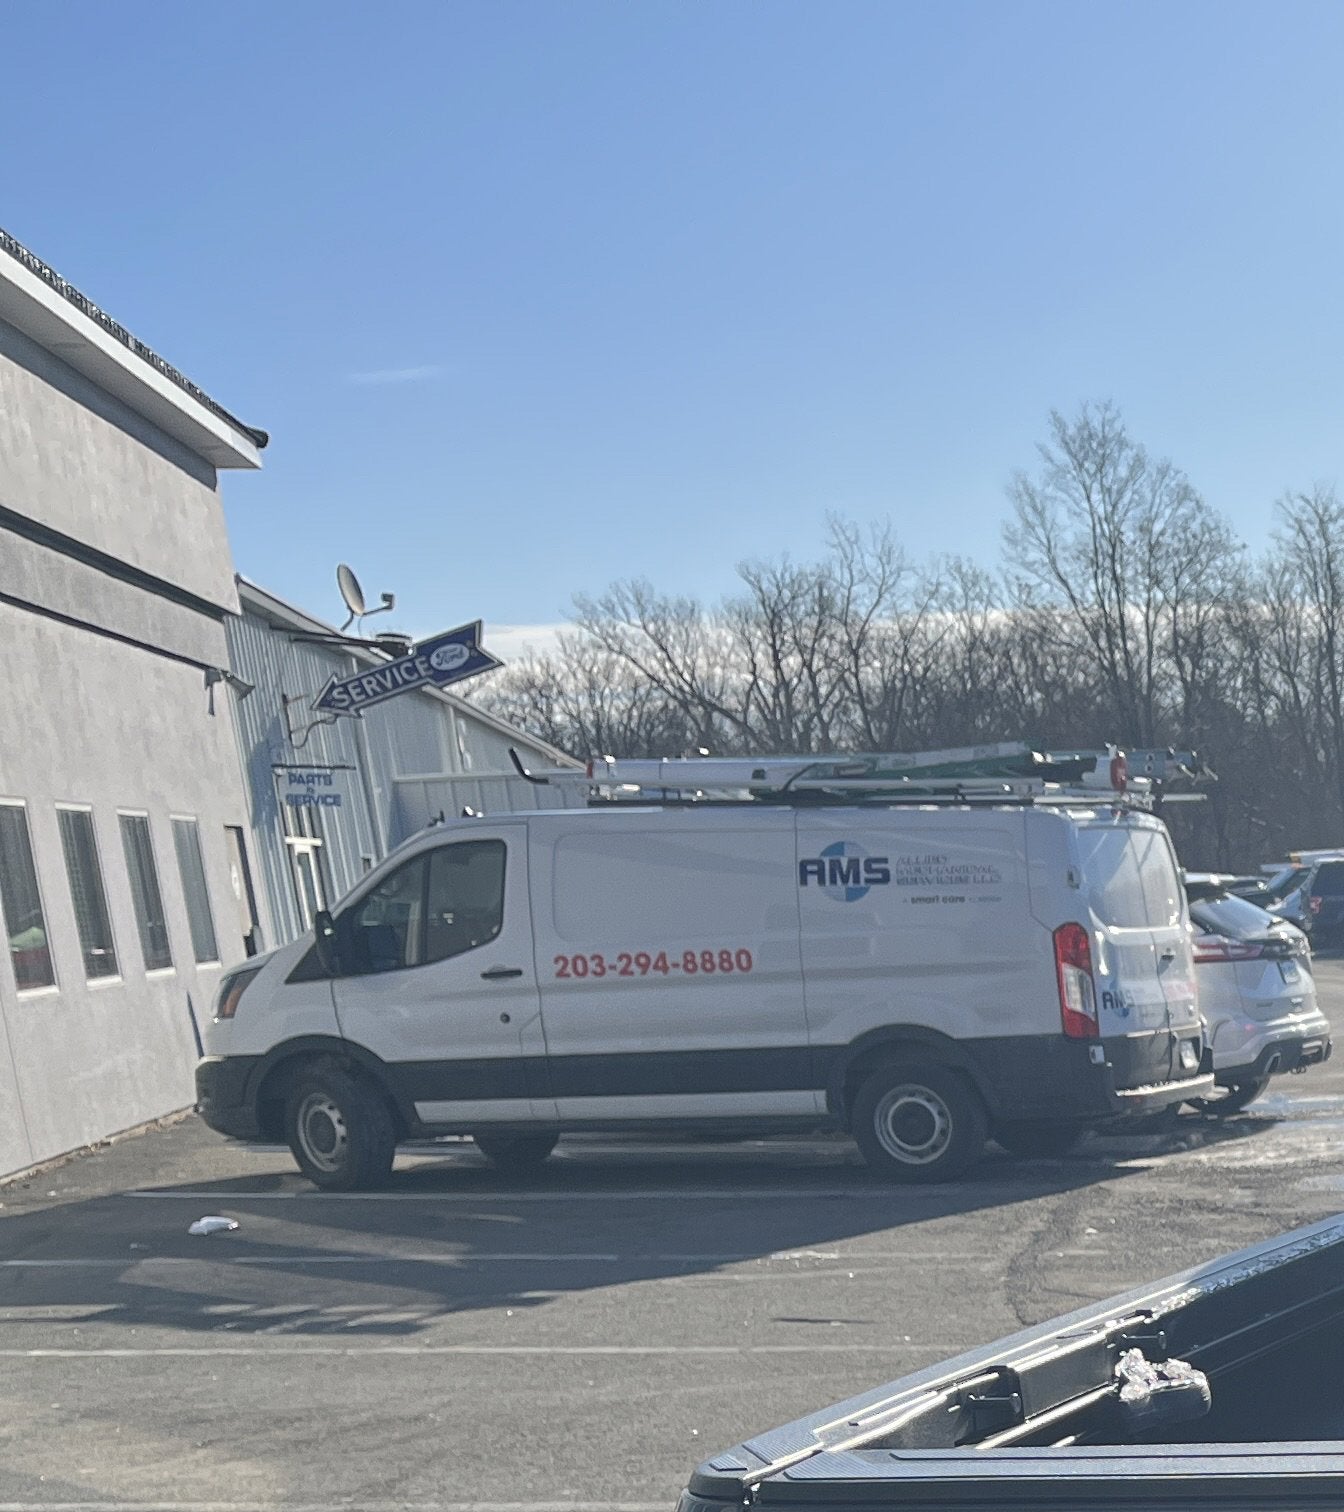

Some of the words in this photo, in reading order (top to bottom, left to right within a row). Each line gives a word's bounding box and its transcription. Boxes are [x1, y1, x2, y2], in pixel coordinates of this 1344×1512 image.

[436, 647, 465, 667] Ford
[331, 656, 433, 708] SERVICE
[288, 773, 333, 785] PARTS
[286, 794, 341, 806] SERVICE
[799, 857, 890, 887] AMS
[553, 949, 753, 978] 203-294-8880
